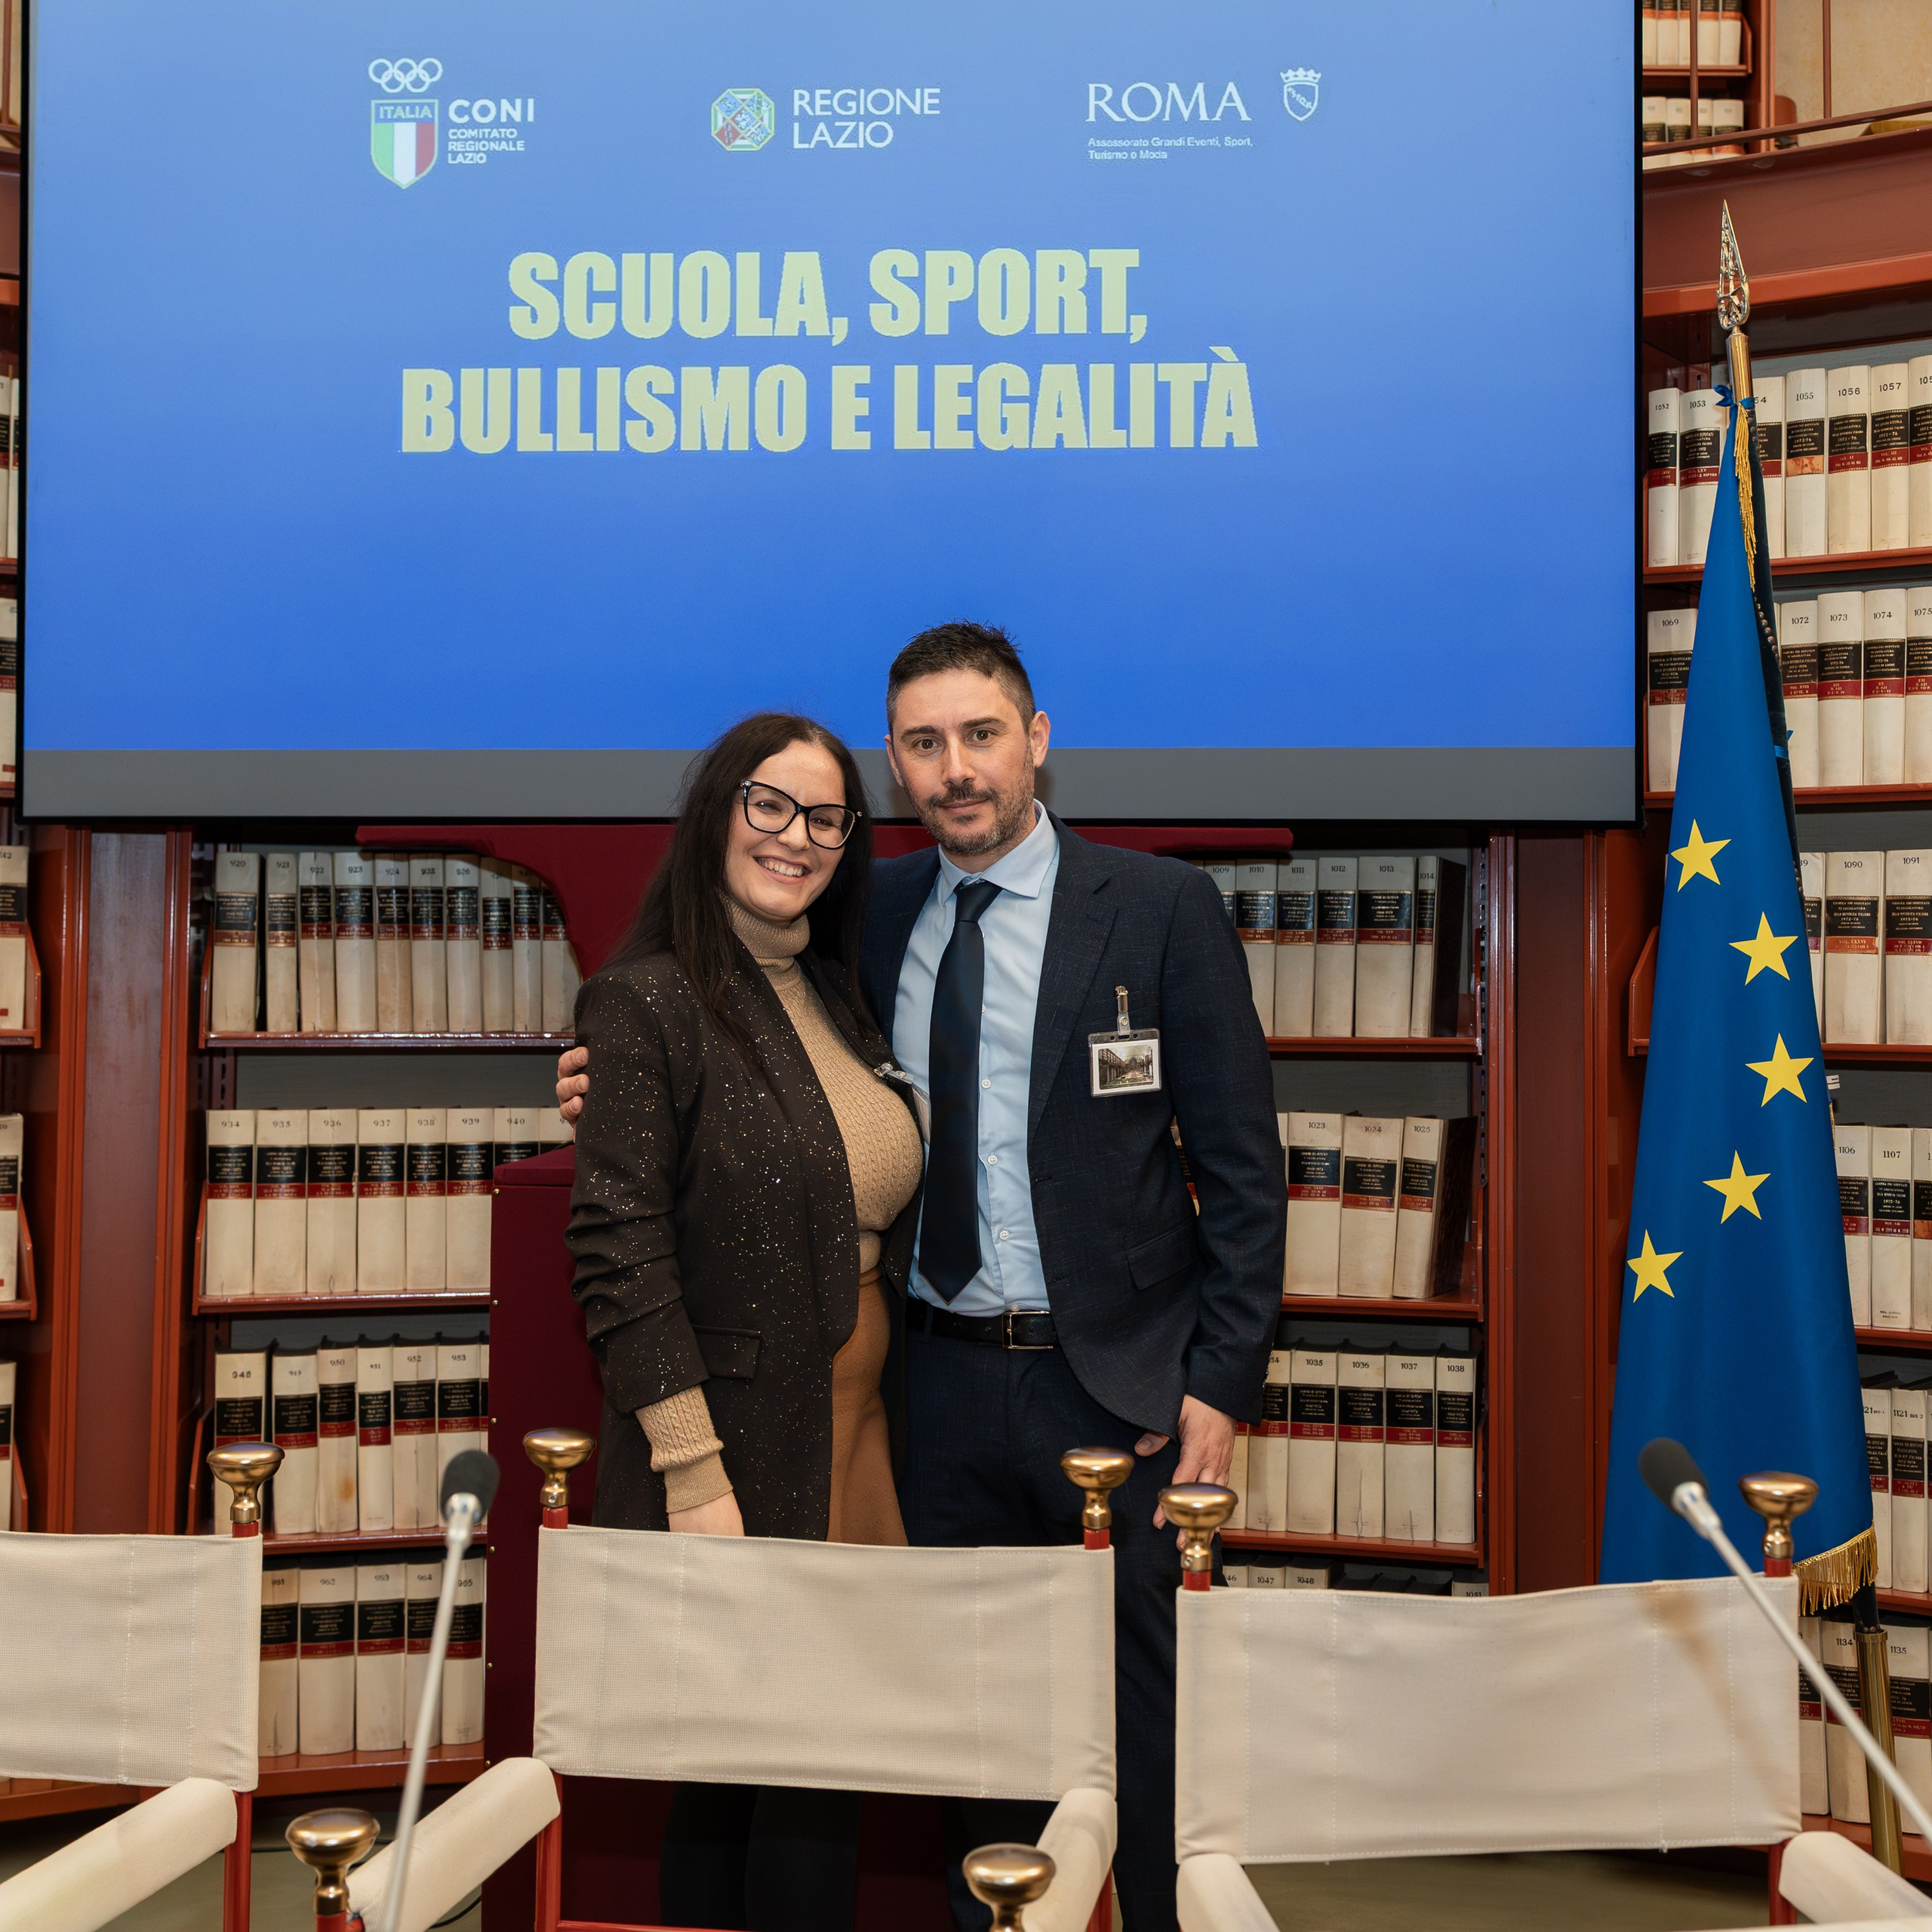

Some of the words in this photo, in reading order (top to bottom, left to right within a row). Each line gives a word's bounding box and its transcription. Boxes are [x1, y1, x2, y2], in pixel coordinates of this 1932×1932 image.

[794, 88, 940, 115] REGIONE
[1086, 82, 1251, 122] ROMA
[378, 106, 432, 119] ITALIA
[449, 98, 534, 123] CONI
[448, 128, 518, 138] COMITATO
[794, 122, 894, 148] LAZIO
[448, 140, 526, 151] REGIONALE
[1088, 137, 1149, 147] Assessorato
[1151, 137, 1185, 147] Grandi
[1187, 137, 1220, 149] Eventi,
[1224, 137, 1253, 147] Sport,
[448, 152, 487, 165] LAZIO
[1088, 151, 1128, 160] Turismo
[509, 251, 848, 346] SCUOLA,
[869, 248, 1147, 343] SPORT,
[1878, 382, 1902, 392] 1057
[1795, 392, 1814, 401] 1055
[1838, 387, 1861, 397] 1056
[401, 365, 808, 454] BULLISMO
[832, 365, 870, 450] E
[894, 345, 1259, 448] LEGALITÀ
[1655, 403, 1669, 411] 1052
[1689, 400, 1706, 410] 1053
[1873, 611, 1893, 620] 1074
[1914, 608, 1932, 617] 1075
[1662, 618, 1679, 627] 1069
[1791, 616, 1809, 625] 1072
[1829, 614, 1848, 622] 1073
[1844, 860, 1863, 869] 1090
[1903, 857, 1920, 865] 1091
[309, 866, 325, 877] 922
[348, 866, 364, 874] 923
[385, 867, 401, 875] 924
[1211, 866, 1230, 875] 1009
[1248, 865, 1265, 874] 1010
[1291, 866, 1305, 875] 1011
[1379, 865, 1395, 873] 1013
[1419, 872, 1435, 881] 1014
[272, 1120, 291, 1128] 935
[323, 1119, 342, 1128] 936
[373, 1118, 391, 1128] 937
[417, 1118, 436, 1127] 938
[506, 1116, 525, 1125] 940
[1308, 1121, 1326, 1130] 1023
[1414, 1125, 1431, 1134] 1025
[1838, 1146, 1856, 1155] 1106
[1883, 1150, 1901, 1158] 1107
[407, 1354, 422, 1364] 952
[1306, 1358, 1324, 1367] 1035
[1352, 1361, 1370, 1369] 1036
[1400, 1362, 1418, 1371] 1037
[1447, 1364, 1465, 1373] 1038
[1892, 1409, 1909, 1418] 1121
[319, 1577, 336, 1586] 962
[417, 1573, 433, 1581] 964
[1257, 1576, 1275, 1585] 1047
[1297, 1576, 1315, 1585] 1048
[1835, 1638, 1854, 1647] 1134
[1890, 1645, 1907, 1654] 1135
